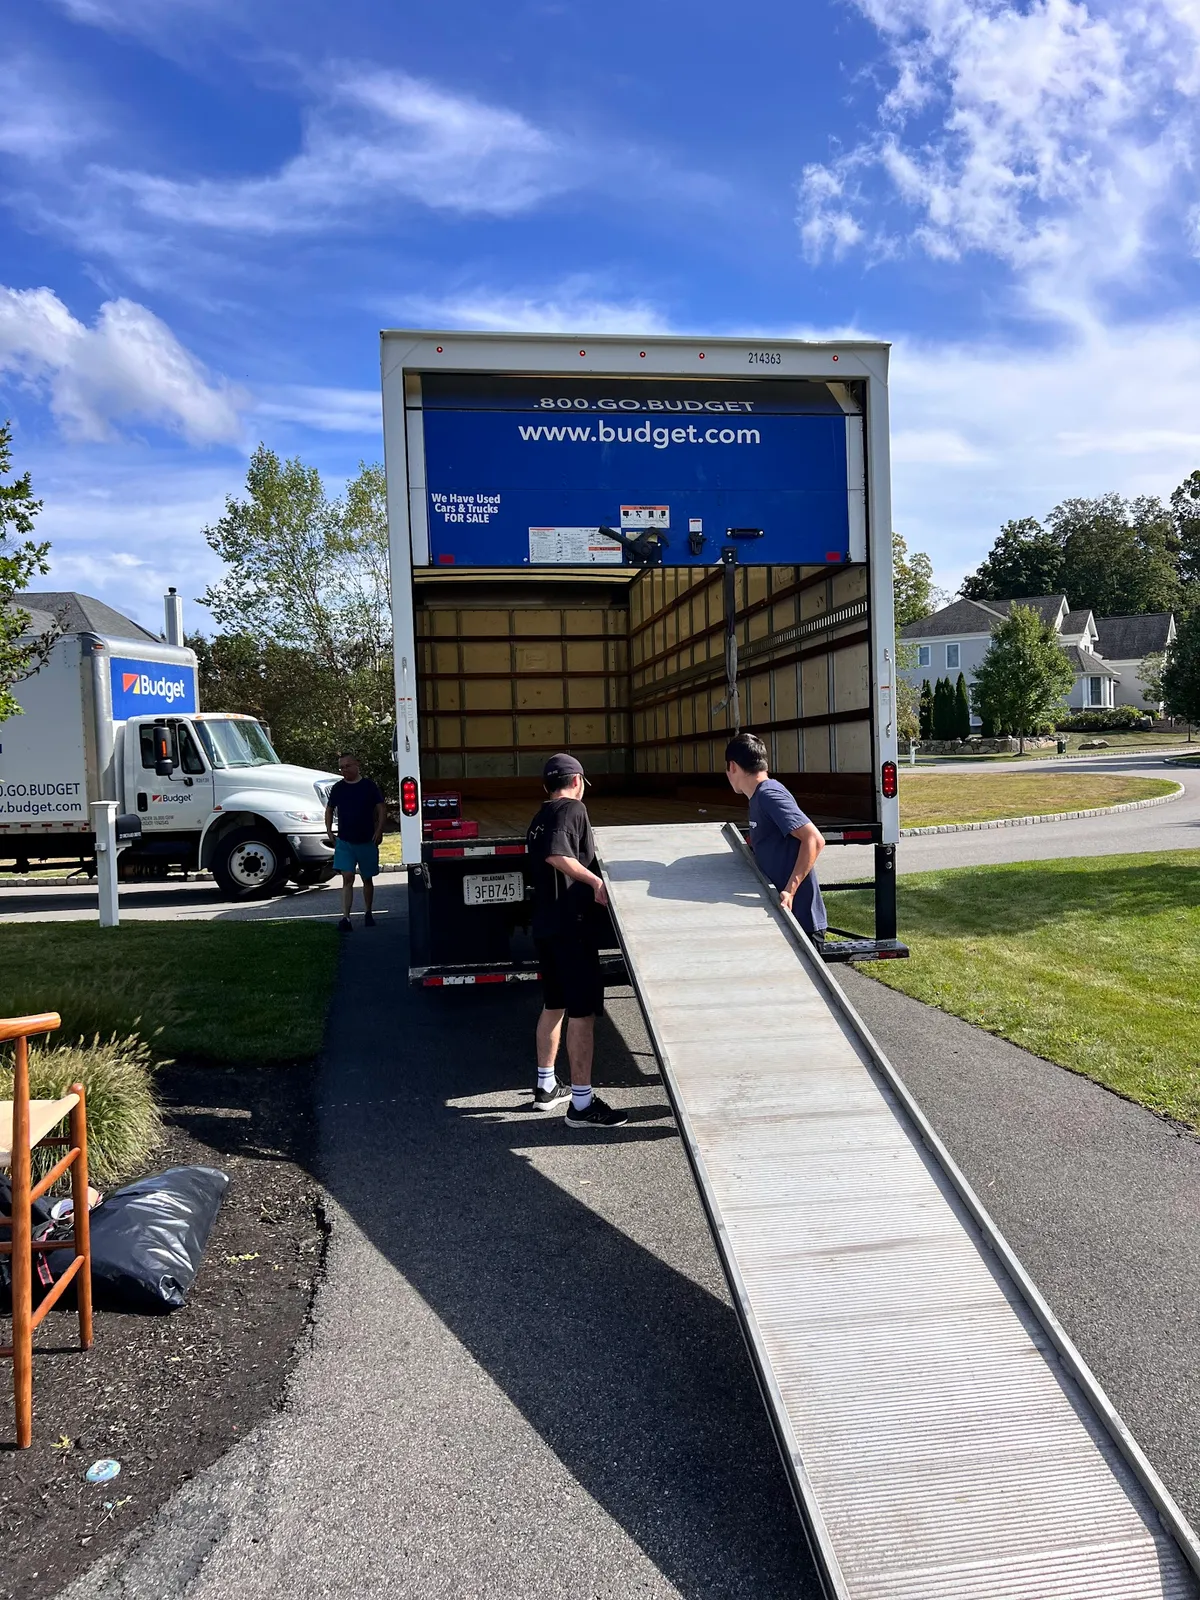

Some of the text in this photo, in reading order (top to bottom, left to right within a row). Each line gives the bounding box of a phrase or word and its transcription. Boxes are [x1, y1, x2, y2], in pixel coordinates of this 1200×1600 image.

[748, 352, 781, 364] 214363
[518, 419, 760, 449] www.budget.com
[431, 493, 501, 504] We Have Used
[434, 503, 499, 514] Cars & Trucks
[444, 513, 490, 523] FOR SALE
[141, 674, 185, 703] Budget
[162, 794, 192, 804] Budget
[475, 883, 515, 899] 3FB745
